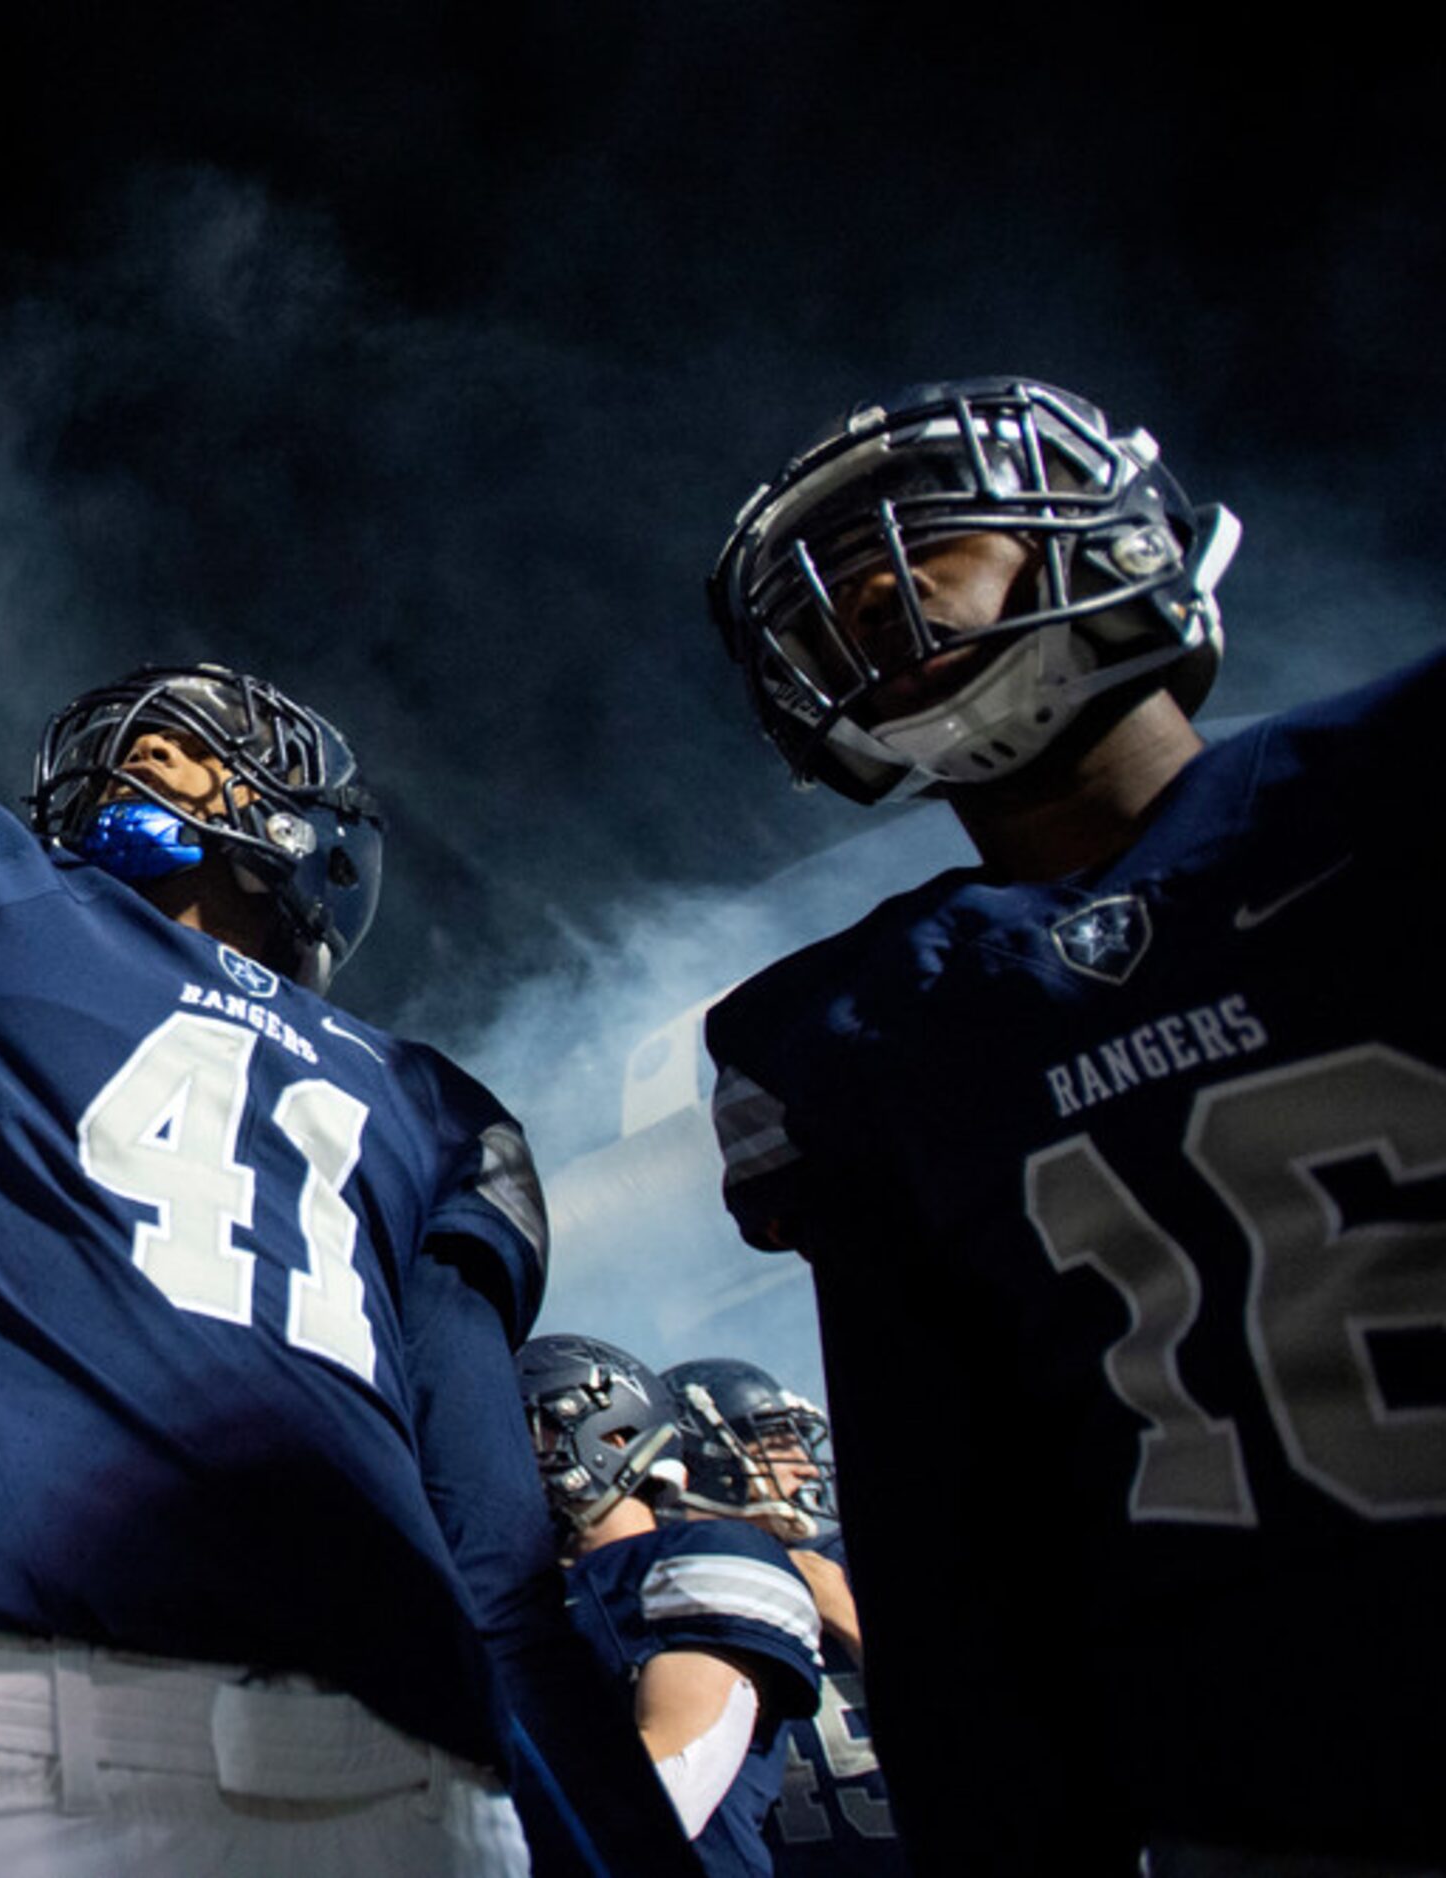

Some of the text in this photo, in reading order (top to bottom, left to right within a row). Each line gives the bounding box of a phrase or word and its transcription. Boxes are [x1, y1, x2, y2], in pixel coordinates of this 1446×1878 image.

[179, 982, 318, 1063] RANGERS
[1045, 994, 1268, 1117] RANGERS
[77, 1010, 376, 1384] 41
